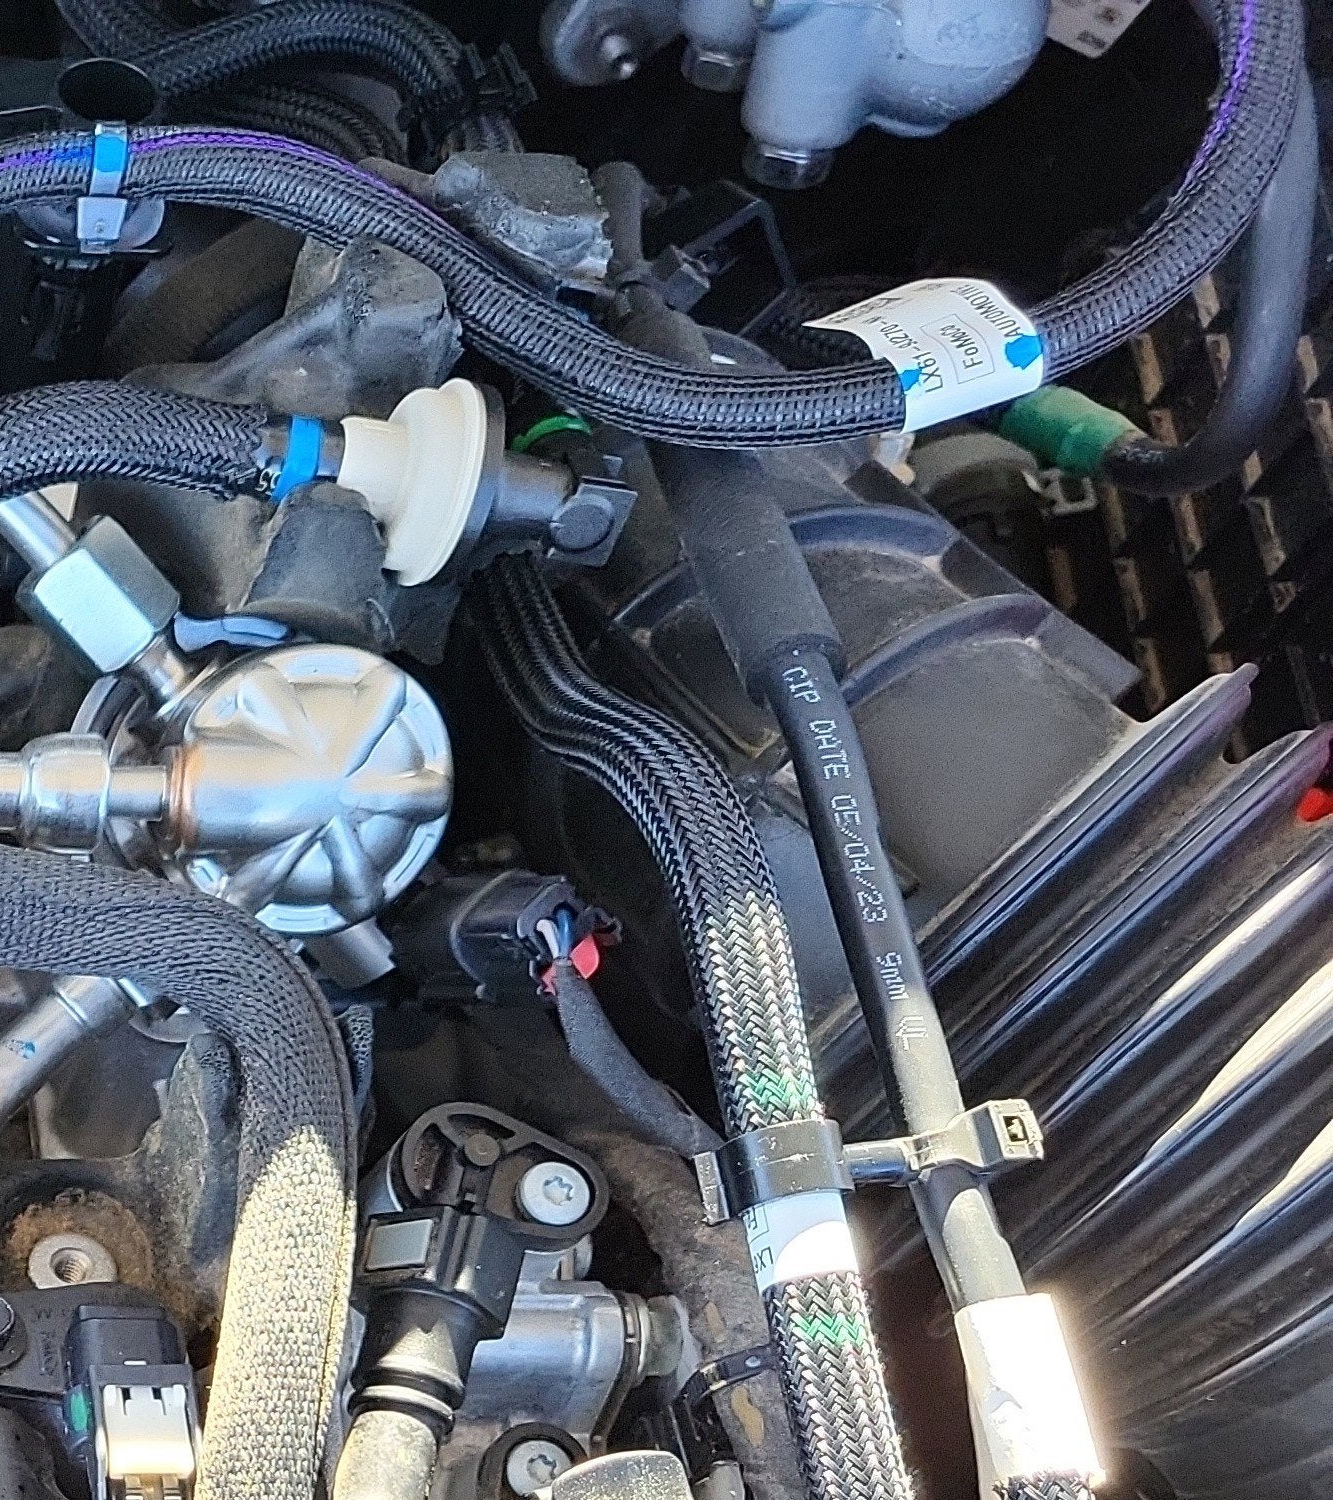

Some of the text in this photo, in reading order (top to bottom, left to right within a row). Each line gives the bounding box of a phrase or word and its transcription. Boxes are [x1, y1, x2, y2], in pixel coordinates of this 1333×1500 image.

[939, 324, 984, 370] FoMoCo
[781, 666, 821, 703] CIP
[808, 720, 850, 780] DATE
[830, 793, 888, 924] 05/04/23
